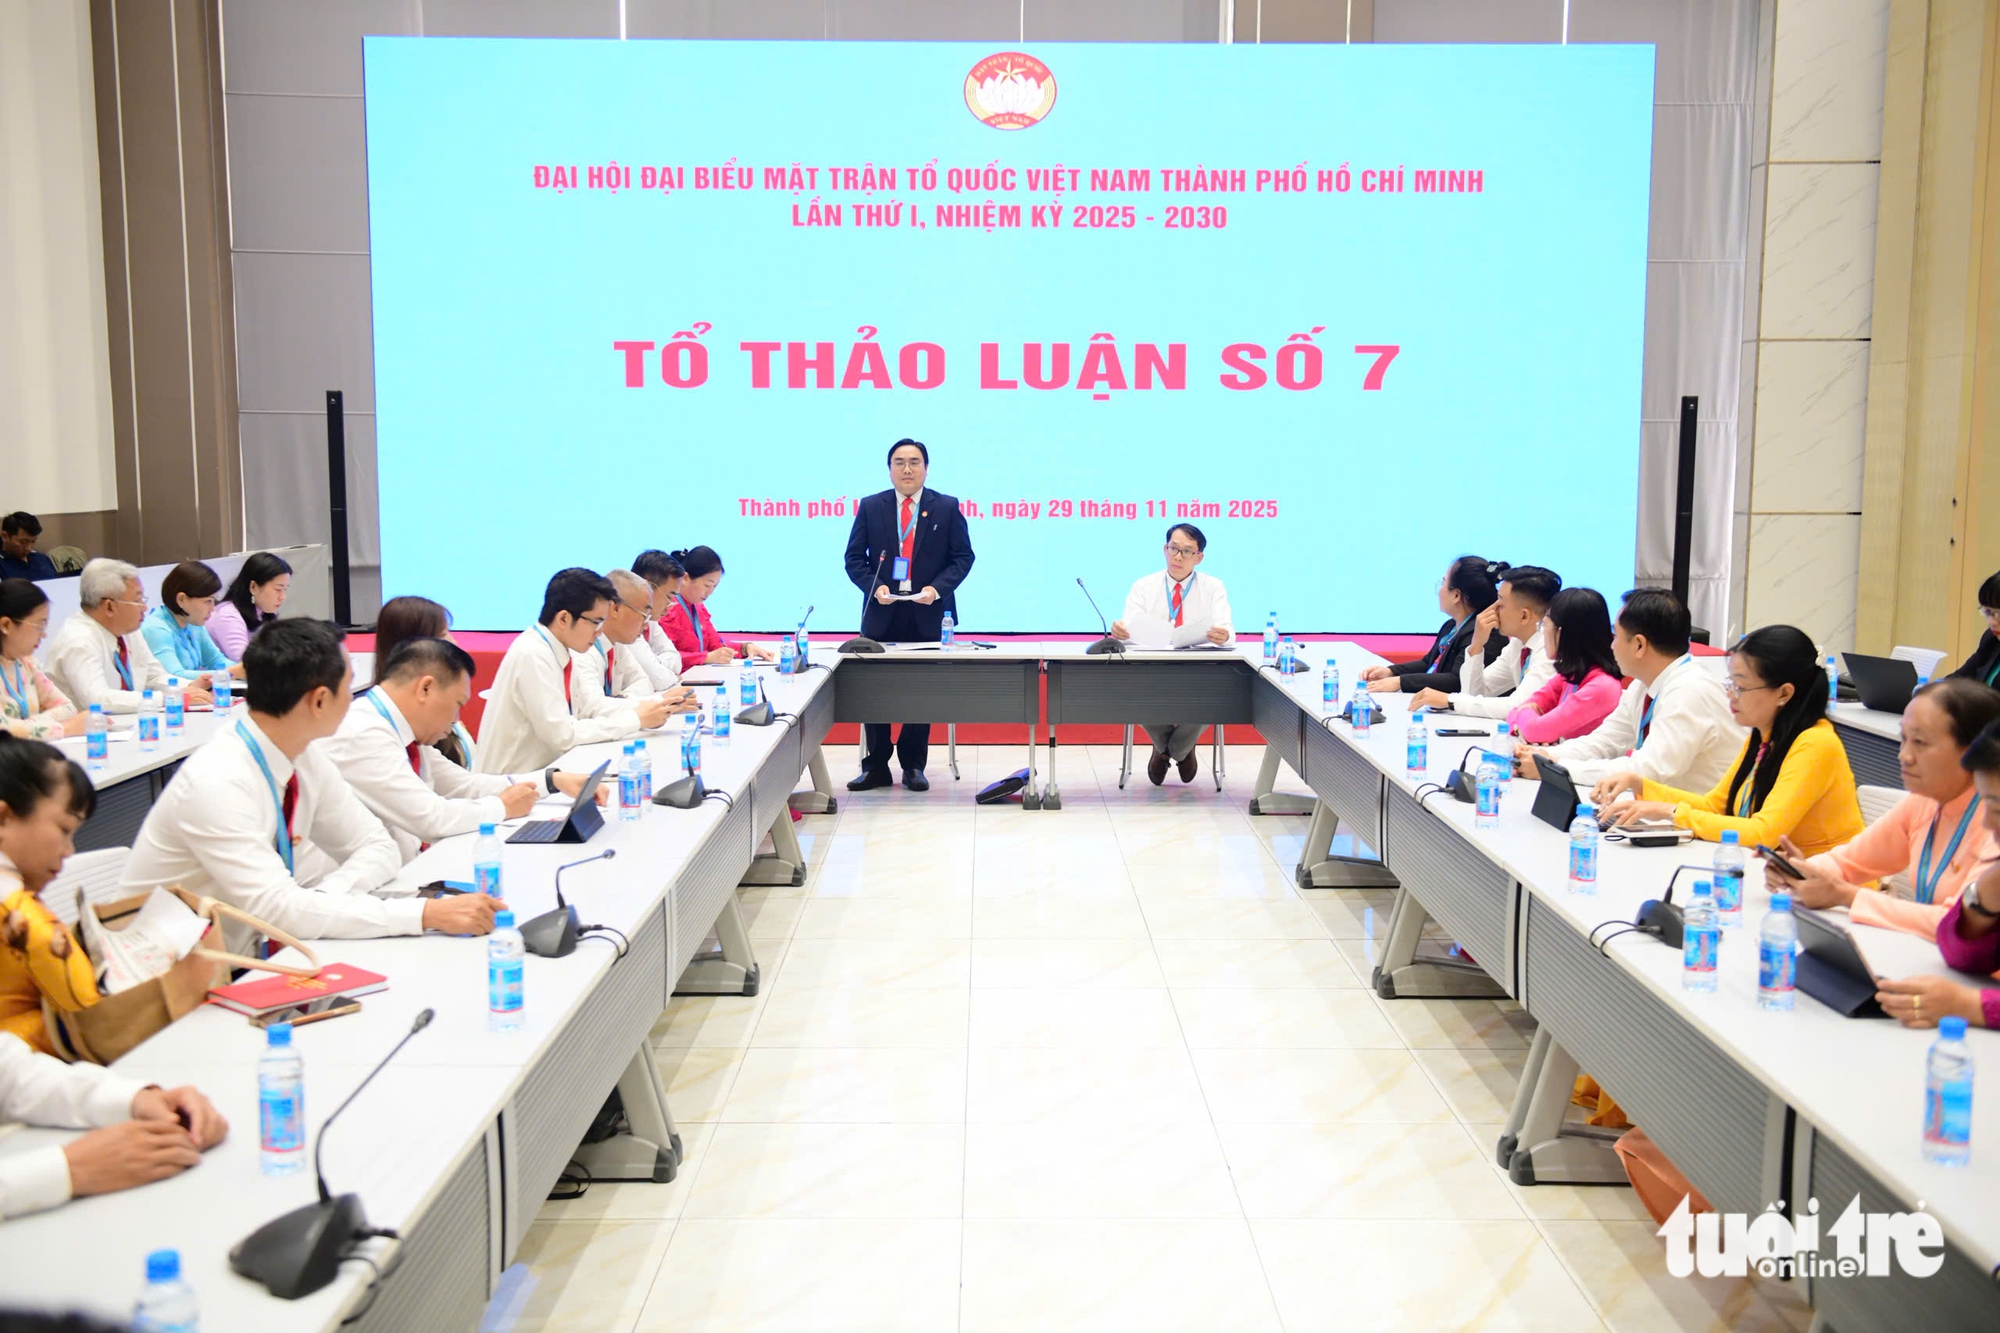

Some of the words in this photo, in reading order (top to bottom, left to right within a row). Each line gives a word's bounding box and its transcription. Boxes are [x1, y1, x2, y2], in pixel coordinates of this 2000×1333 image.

[534, 165, 578, 194] ĐẠI
[588, 160, 631, 195] HỘI
[641, 165, 685, 195] ĐẠI
[695, 156, 754, 190] BIỂU
[764, 162, 820, 197] MẶT
[829, 162, 896, 196] TRẬN
[906, 157, 938, 191] TỔ
[948, 159, 1017, 194] QUỐC
[1026, 163, 1081, 197] VIỆT
[1091, 168, 1151, 192] NAM
[1160, 163, 1247, 193] THÀNH
[1256, 160, 1308, 193] PHỐ
[1318, 161, 1351, 193] HỒ
[1361, 164, 1404, 193] CHÍ
[1414, 169, 1484, 193] MINH
[792, 195, 842, 227] LẦN
[852, 199, 904, 227] THỨ
[911, 204, 926, 230] I,
[936, 199, 1021, 233] NHIỆM
[1031, 199, 1063, 228] KỲ
[1073, 205, 1136, 229] 2025
[1164, 205, 1228, 229] 2030
[613, 321, 713, 389] TỔ
[740, 325, 946, 391] THẢO
[979, 332, 1187, 401] LUẬN
[1219, 326, 1327, 392] SỐ
[1355, 344, 1401, 391] 7
[739, 498, 801, 517] Thành
[807, 496, 847, 519] phố
[992, 499, 1041, 520] ngày
[1048, 499, 1073, 518] 29
[1080, 499, 1137, 520] tháng
[1145, 499, 1167, 518] 11
[1177, 499, 1221, 518] năm
[1228, 499, 1279, 518] 2025
